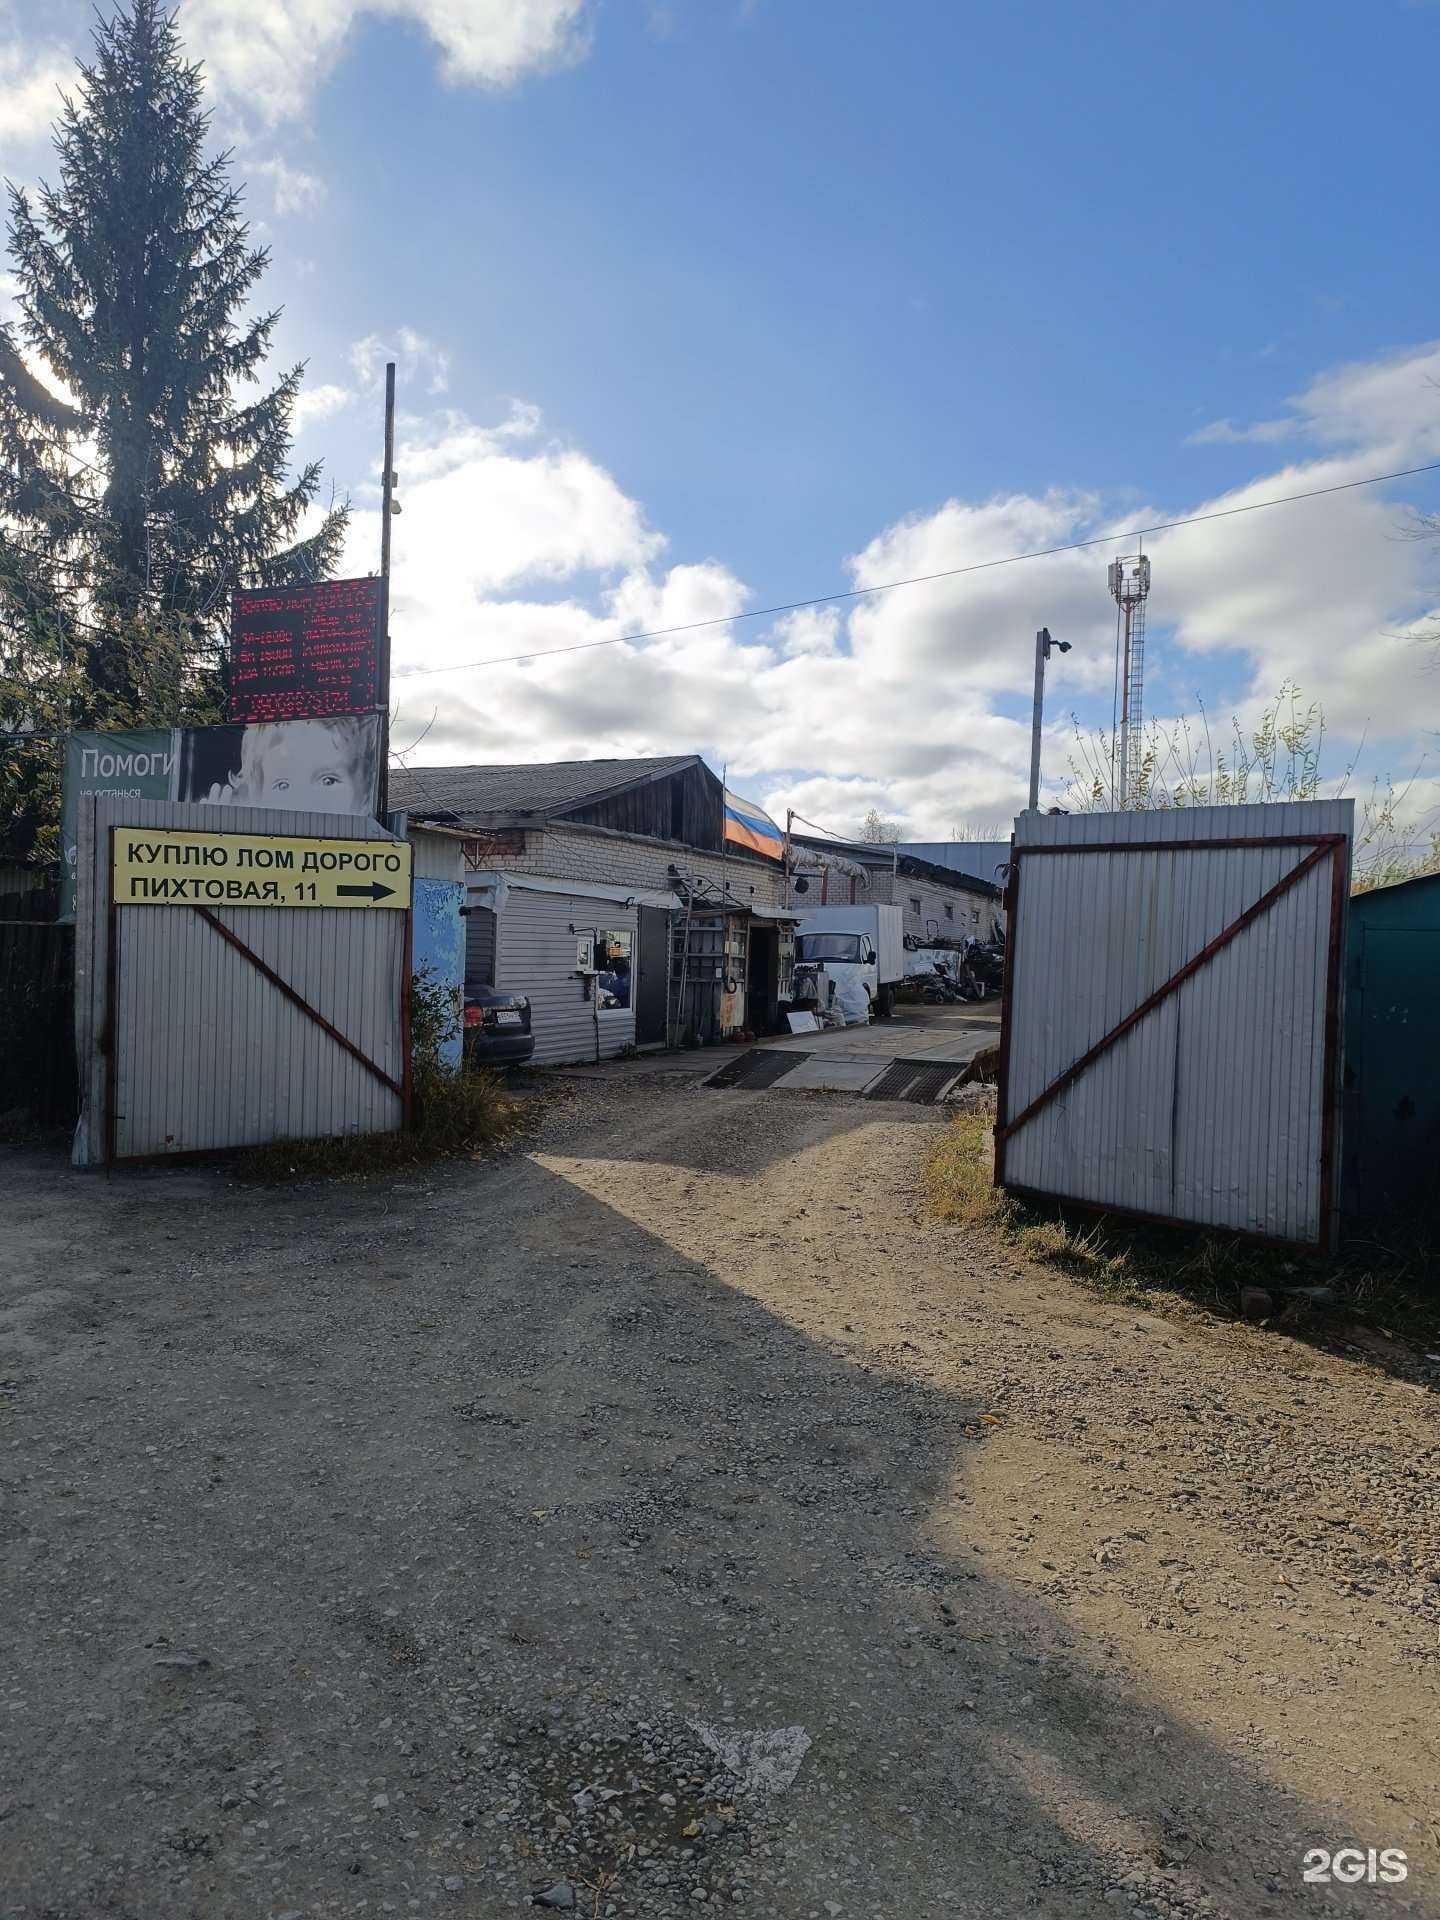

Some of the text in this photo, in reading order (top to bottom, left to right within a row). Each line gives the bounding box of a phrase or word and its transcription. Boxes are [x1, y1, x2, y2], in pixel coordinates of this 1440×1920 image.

[81, 749, 180, 778] Помоги
[128, 843, 401, 873] КУПЛЮ ЛОМ ДОРОГО
[130, 877, 316, 903] ПИХТОВАЯ, 11
